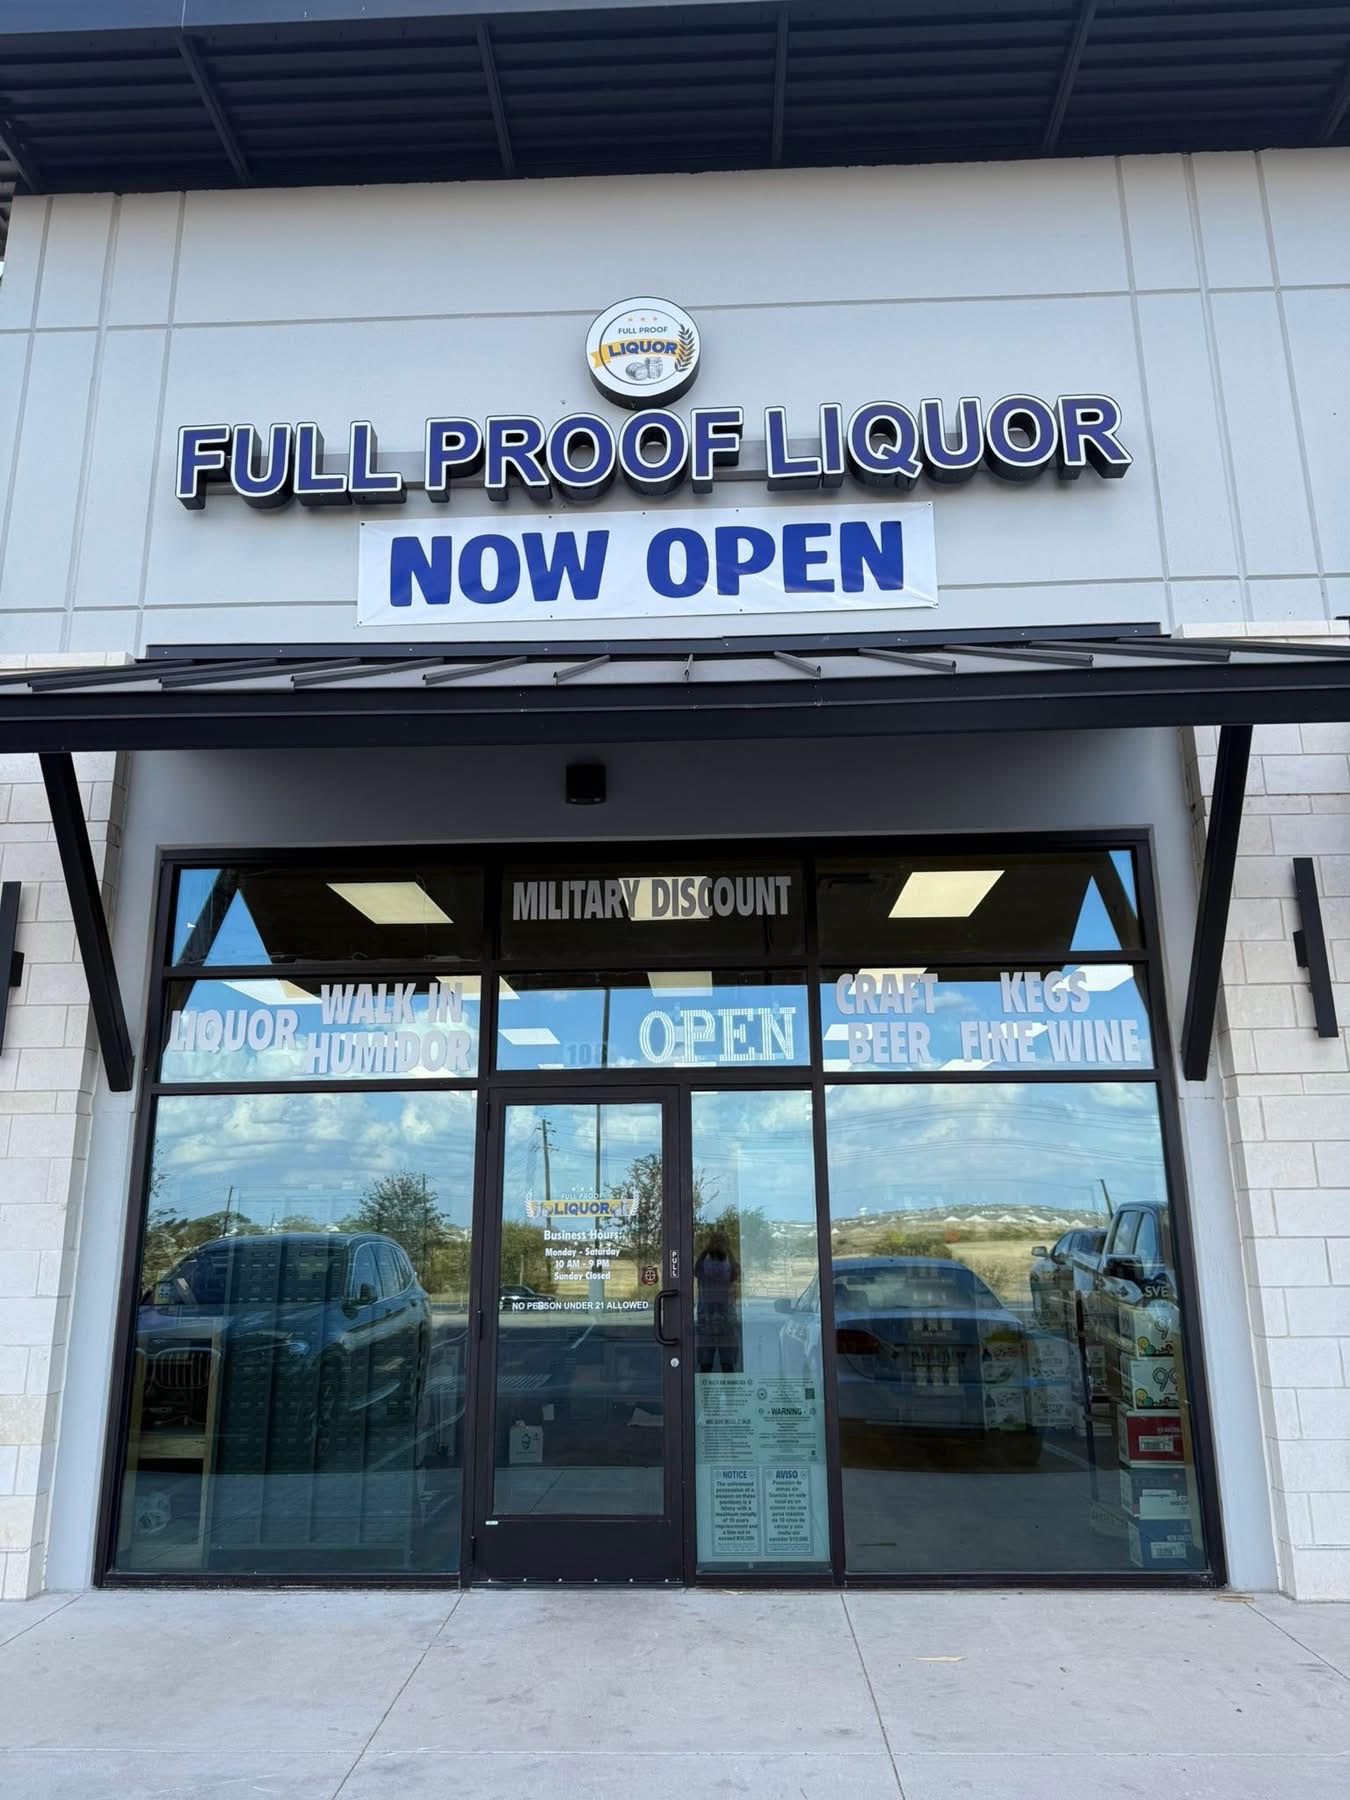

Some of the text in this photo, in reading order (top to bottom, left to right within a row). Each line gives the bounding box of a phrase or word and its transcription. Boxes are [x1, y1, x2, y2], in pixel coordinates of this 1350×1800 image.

[639, 326, 668, 334] PROOF
[608, 341, 678, 357] LIQUOR
[176, 393, 1134, 499] FULL PROOF LIQUOR
[389, 520, 905, 607] NOW OPEN
[512, 876, 792, 921] MILITARY DISCOUNT
[320, 981, 463, 1025] WALK IN
[836, 973, 939, 1015] CRAFT
[1000, 971, 1090, 1014] KEGS
[170, 1009, 299, 1053] LIQUOR
[639, 1007, 797, 1064] OPEN
[848, 1021, 931, 1064] BEER
[960, 1019, 1141, 1063] FINE WINE
[304, 1030, 471, 1074] HUMIDOR
[554, 1202, 610, 1216] LIQUOR
[544, 1230, 623, 1241] Business Hours:
[545, 1248, 577, 1257] Monday
[585, 1247, 620, 1257] Saturday
[555, 1260, 564, 1268] 10
[567, 1260, 580, 1268] AM
[588, 1260, 594, 1268] 9
[596, 1260, 610, 1268] PM
[554, 1271, 611, 1280] Sunday Closed
[512, 1301, 649, 1310] NO PERSON UNDER 21 ALLOWED
[771, 1408, 802, 1416] WARNING
[722, 1471, 748, 1479] NOTICE
[776, 1470, 799, 1478] AVISO
